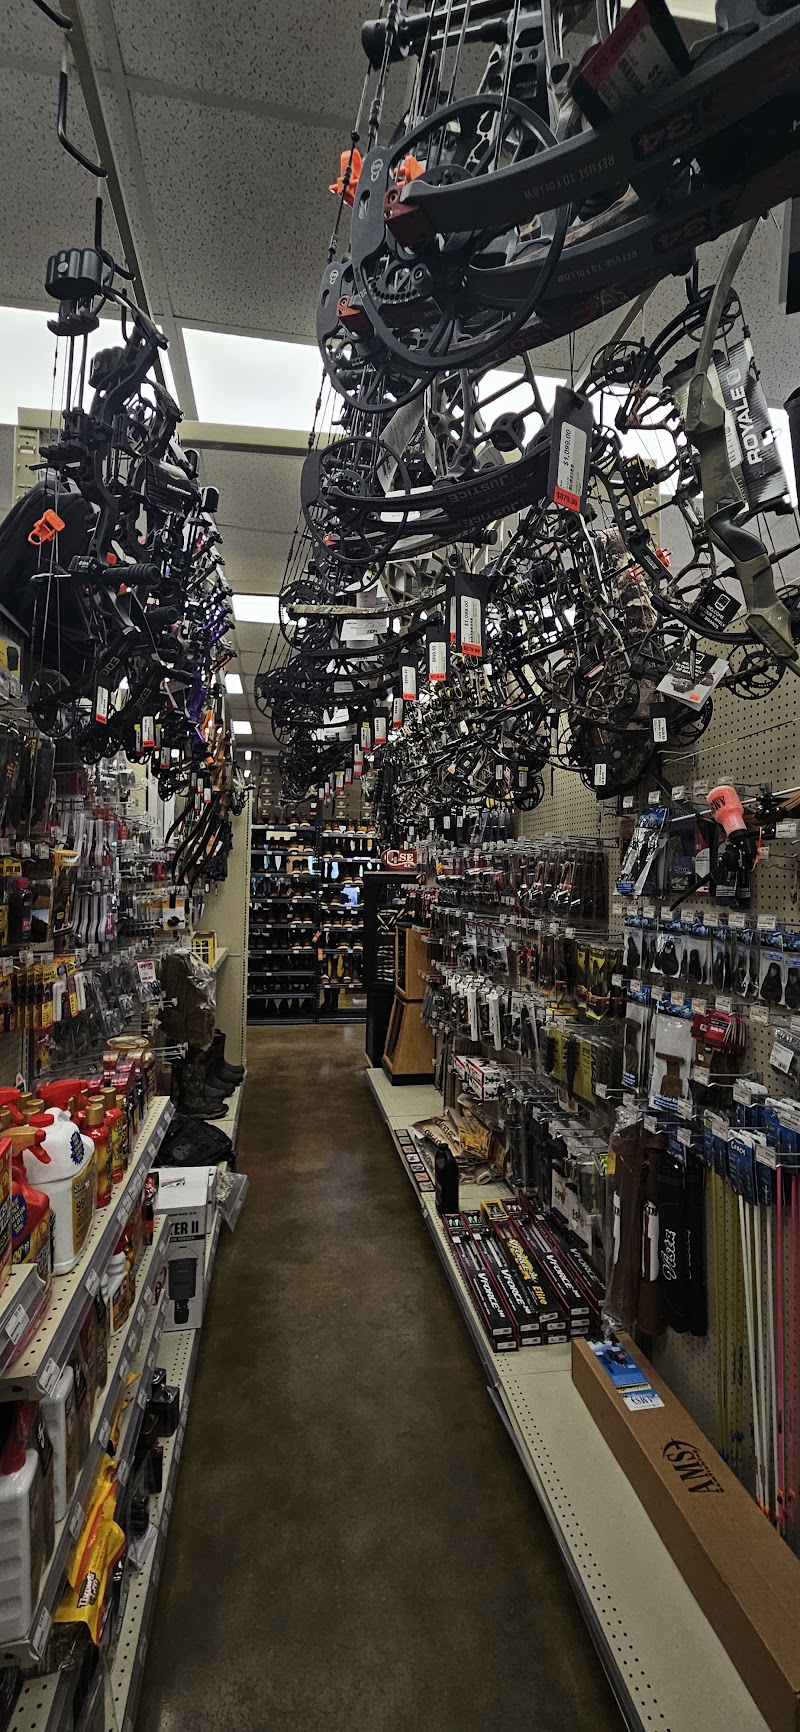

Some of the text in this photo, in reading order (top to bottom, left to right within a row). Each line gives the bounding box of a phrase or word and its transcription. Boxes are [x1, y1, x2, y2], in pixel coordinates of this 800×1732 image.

[523, 153, 615, 200] REFUSE TO FOLLOW
[557, 249, 638, 283] REFUSE TO FOLLOW
[729, 385, 763, 466] ROYALE
[447, 474, 510, 502] JUSTICE
[459, 501, 521, 527] JUSTICE
[386, 849, 414, 866] CSE
[531, 1285, 548, 1305] Elite
[665, 1451, 721, 1493] AMS
